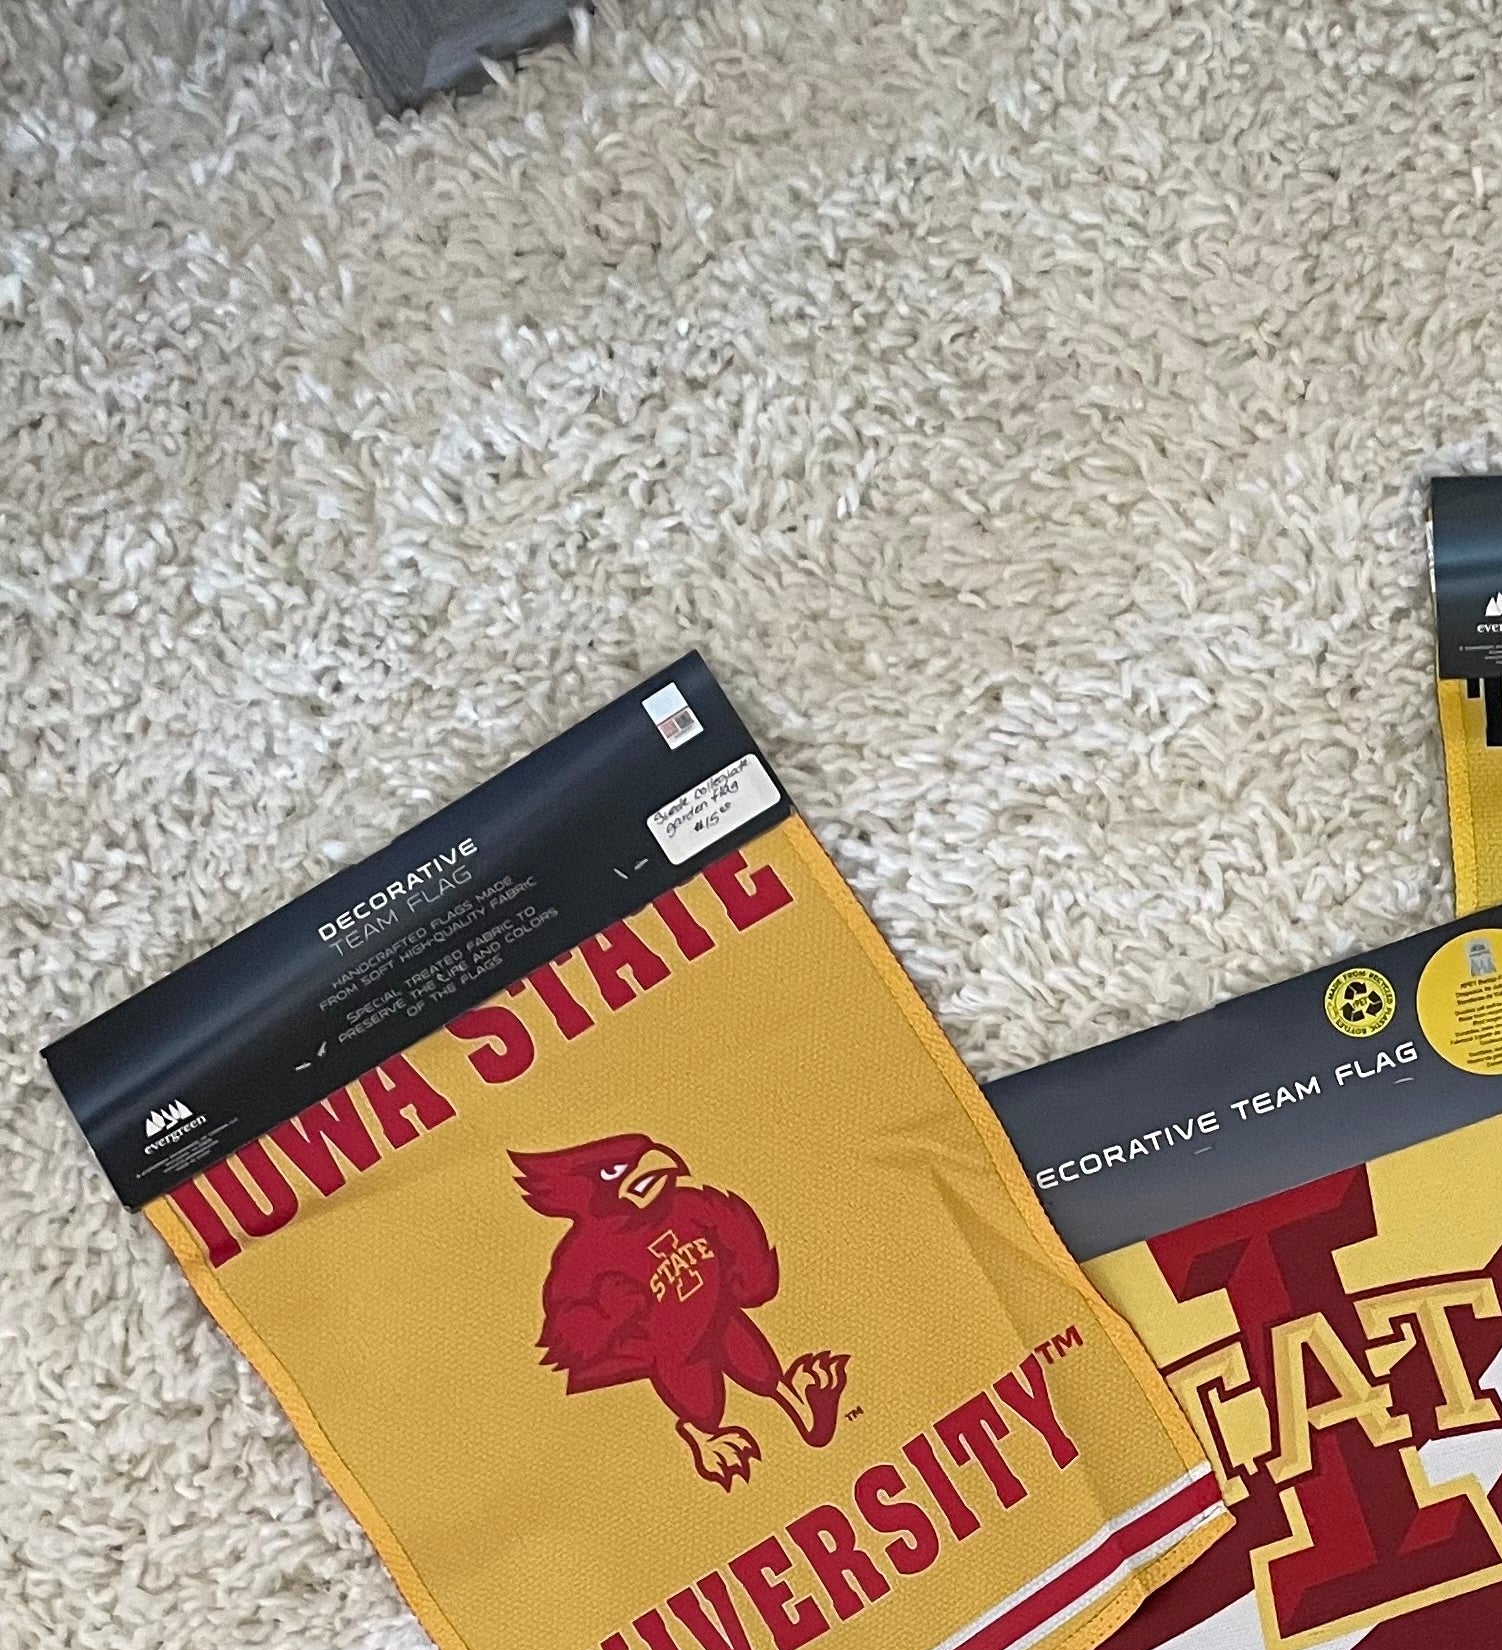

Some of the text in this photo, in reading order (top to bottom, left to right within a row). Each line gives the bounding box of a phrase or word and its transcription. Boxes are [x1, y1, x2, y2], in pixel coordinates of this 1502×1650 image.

[318, 837, 479, 942] DECORATIVE
[319, 983, 358, 1013] FROM
[361, 961, 395, 986] SOFT
[490, 876, 538, 909] FABRIC
[328, 864, 473, 957] TEAM FLAG
[332, 875, 513, 990] HANDCRAFTED FLAGS MADE
[338, 999, 407, 1044] PRESERVE
[410, 981, 436, 1000] THE
[472, 940, 501, 963] AND
[504, 907, 559, 944] COLORS
[346, 905, 536, 1024] SPECIAL TREATED FABRIC TO
[406, 955, 504, 1018] OF THE FLAGS
[165, 850, 794, 1268] IOWA STATE
[1036, 1110, 1221, 1192] ECORATIVE
[1231, 1075, 1321, 1122] TEAM
[1333, 1041, 1418, 1087] FLAG
[144, 1115, 207, 1155] evergreen
[650, 1237, 715, 1303] STATE
